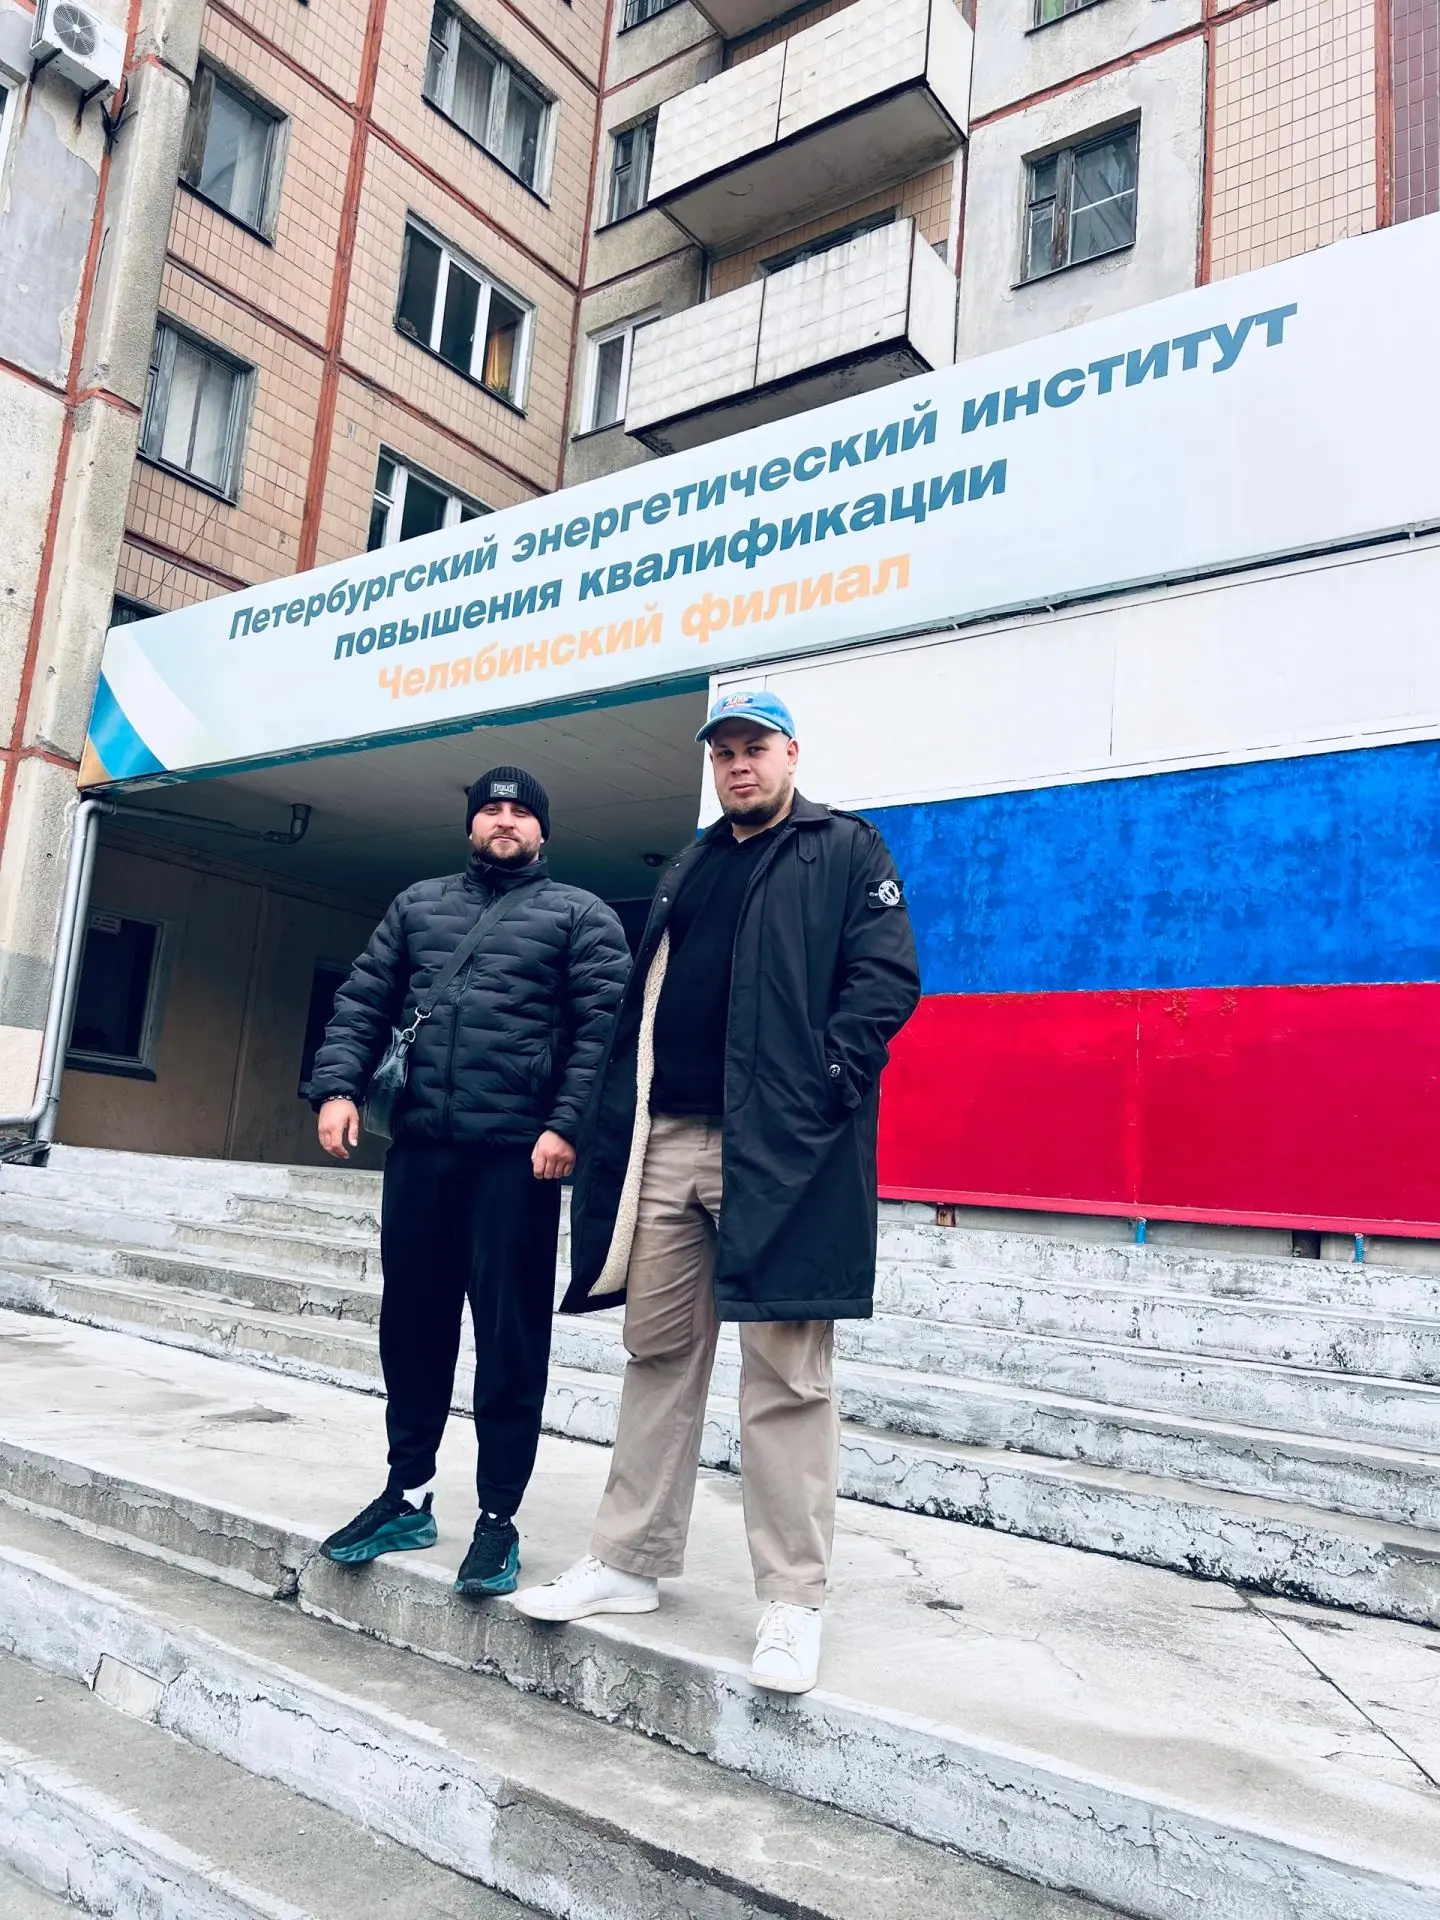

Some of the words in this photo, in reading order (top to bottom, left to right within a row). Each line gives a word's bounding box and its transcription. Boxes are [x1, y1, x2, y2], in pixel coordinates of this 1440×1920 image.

[229, 535, 499, 640] Петербургский
[511, 400, 938, 563] энергетический
[961, 302, 1298, 433] институт
[333, 579, 563, 660] повышения
[578, 458, 1008, 601] квалификации
[378, 602, 663, 700] Челябинский
[681, 554, 911, 644] филиал
